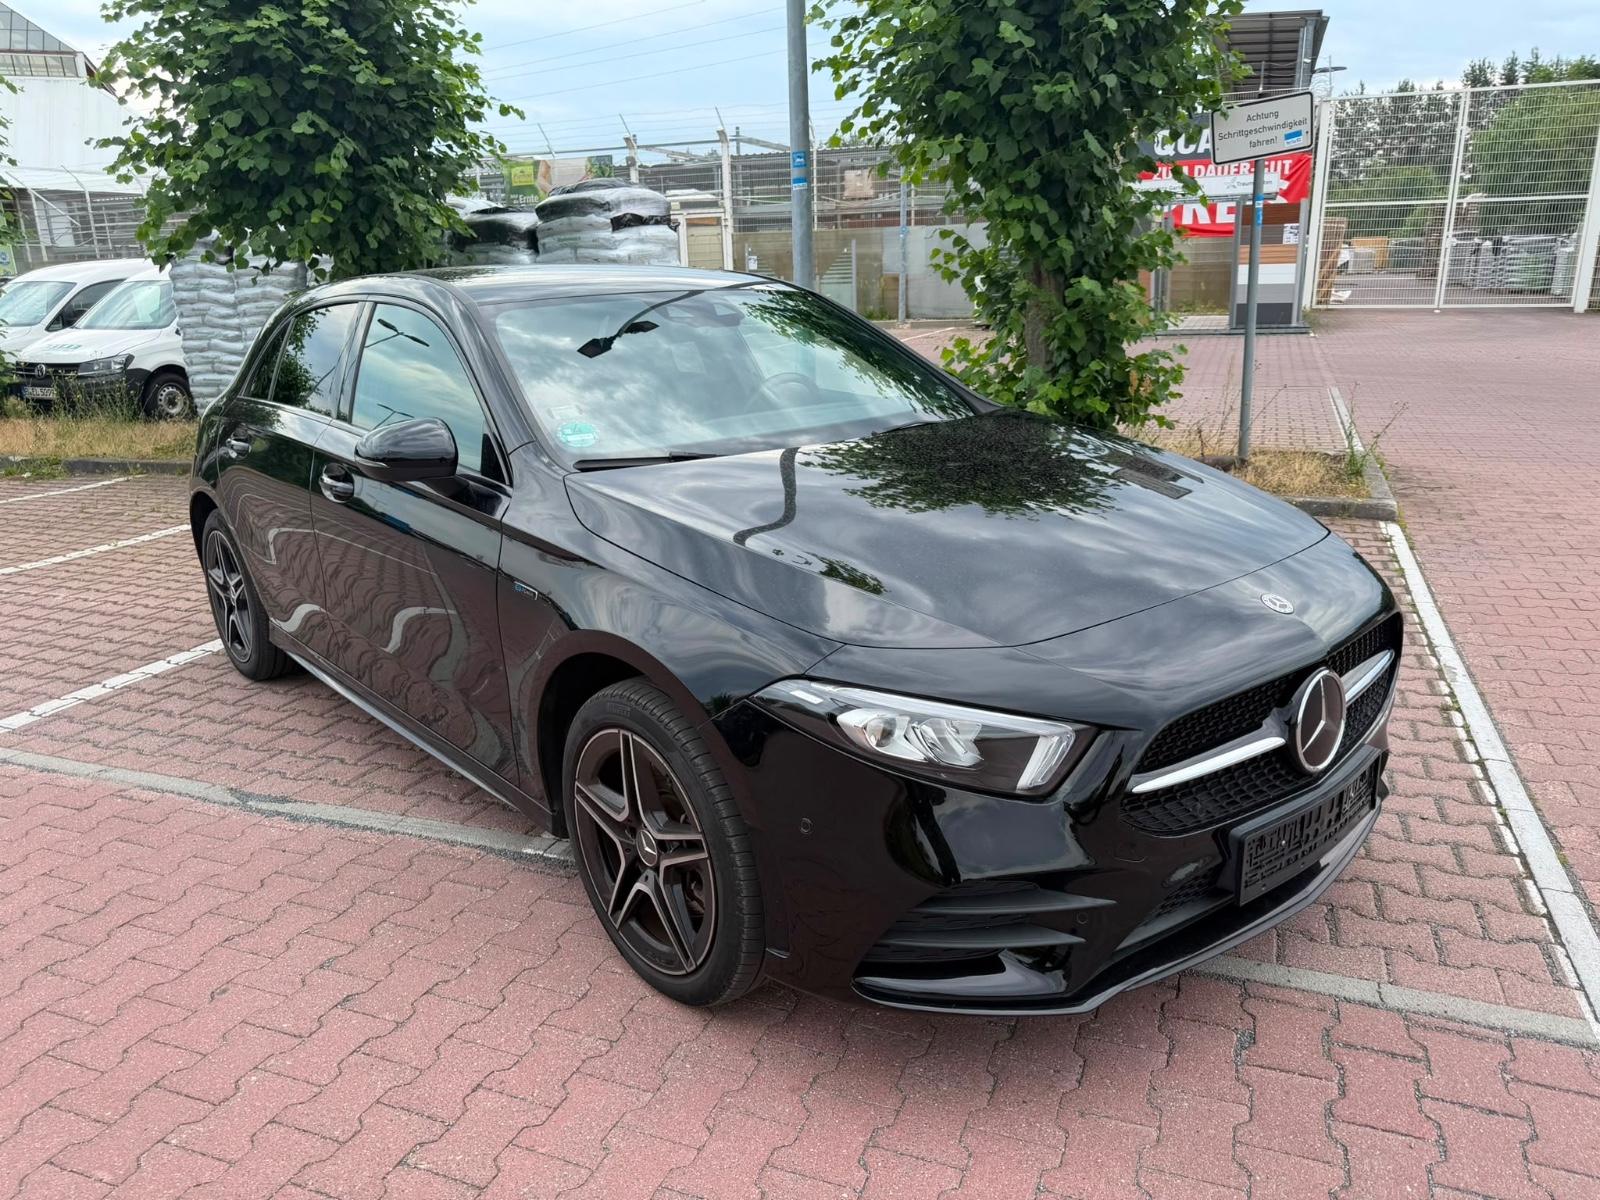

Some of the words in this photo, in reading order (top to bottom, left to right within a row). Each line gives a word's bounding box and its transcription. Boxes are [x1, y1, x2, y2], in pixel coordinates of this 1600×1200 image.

[1246, 111, 1279, 122] Achtung
[1218, 118, 1308, 141] Schrittgeschwindigkeit
[1249, 136, 1278, 149] fahren!
